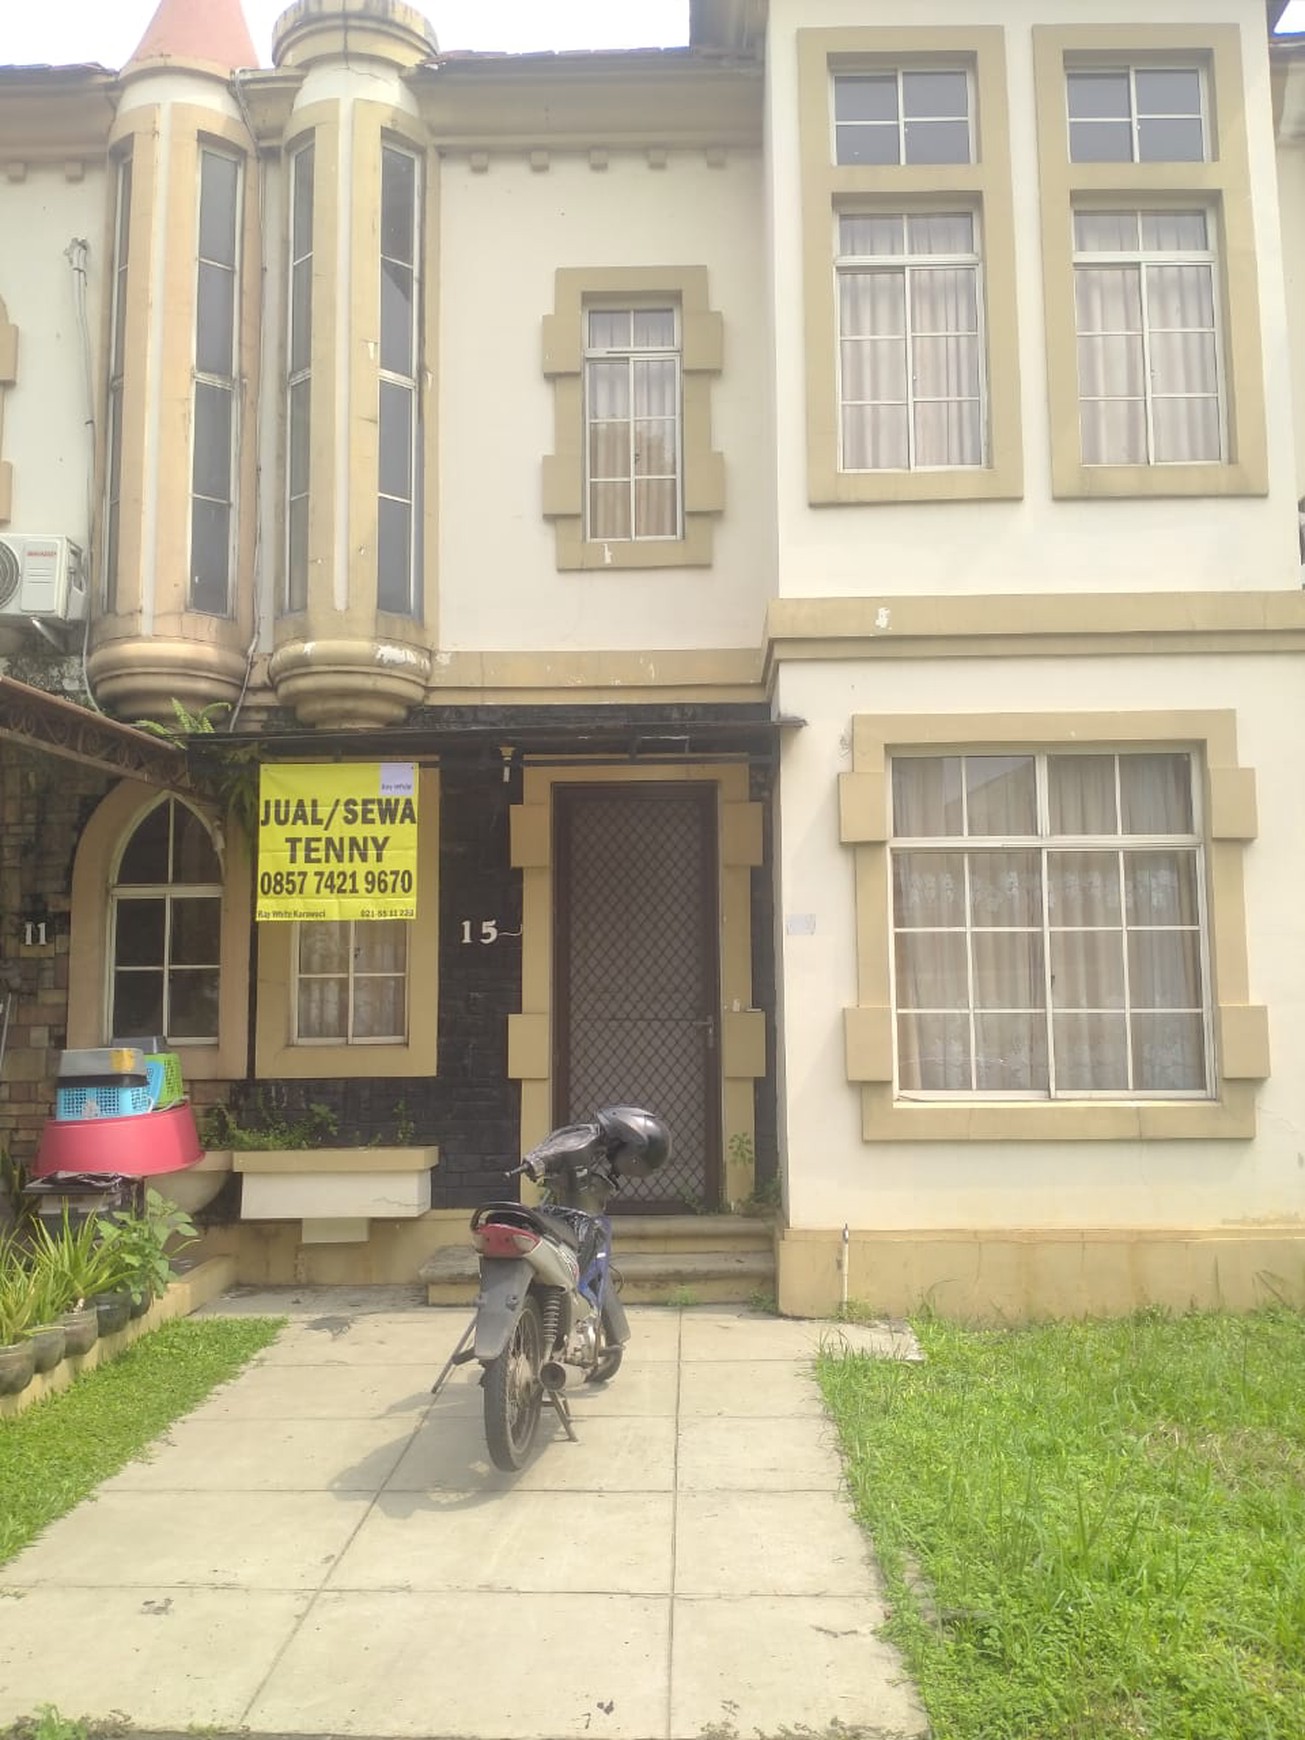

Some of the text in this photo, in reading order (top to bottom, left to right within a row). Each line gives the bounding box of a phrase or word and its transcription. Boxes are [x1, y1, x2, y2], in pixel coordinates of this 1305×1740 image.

[261, 798, 416, 831] JUAL/SEWA
[285, 836, 390, 864] TENNY
[260, 870, 412, 895] 0857 7421 9670
[25, 921, 47, 945] 11
[462, 920, 497, 944] 15
